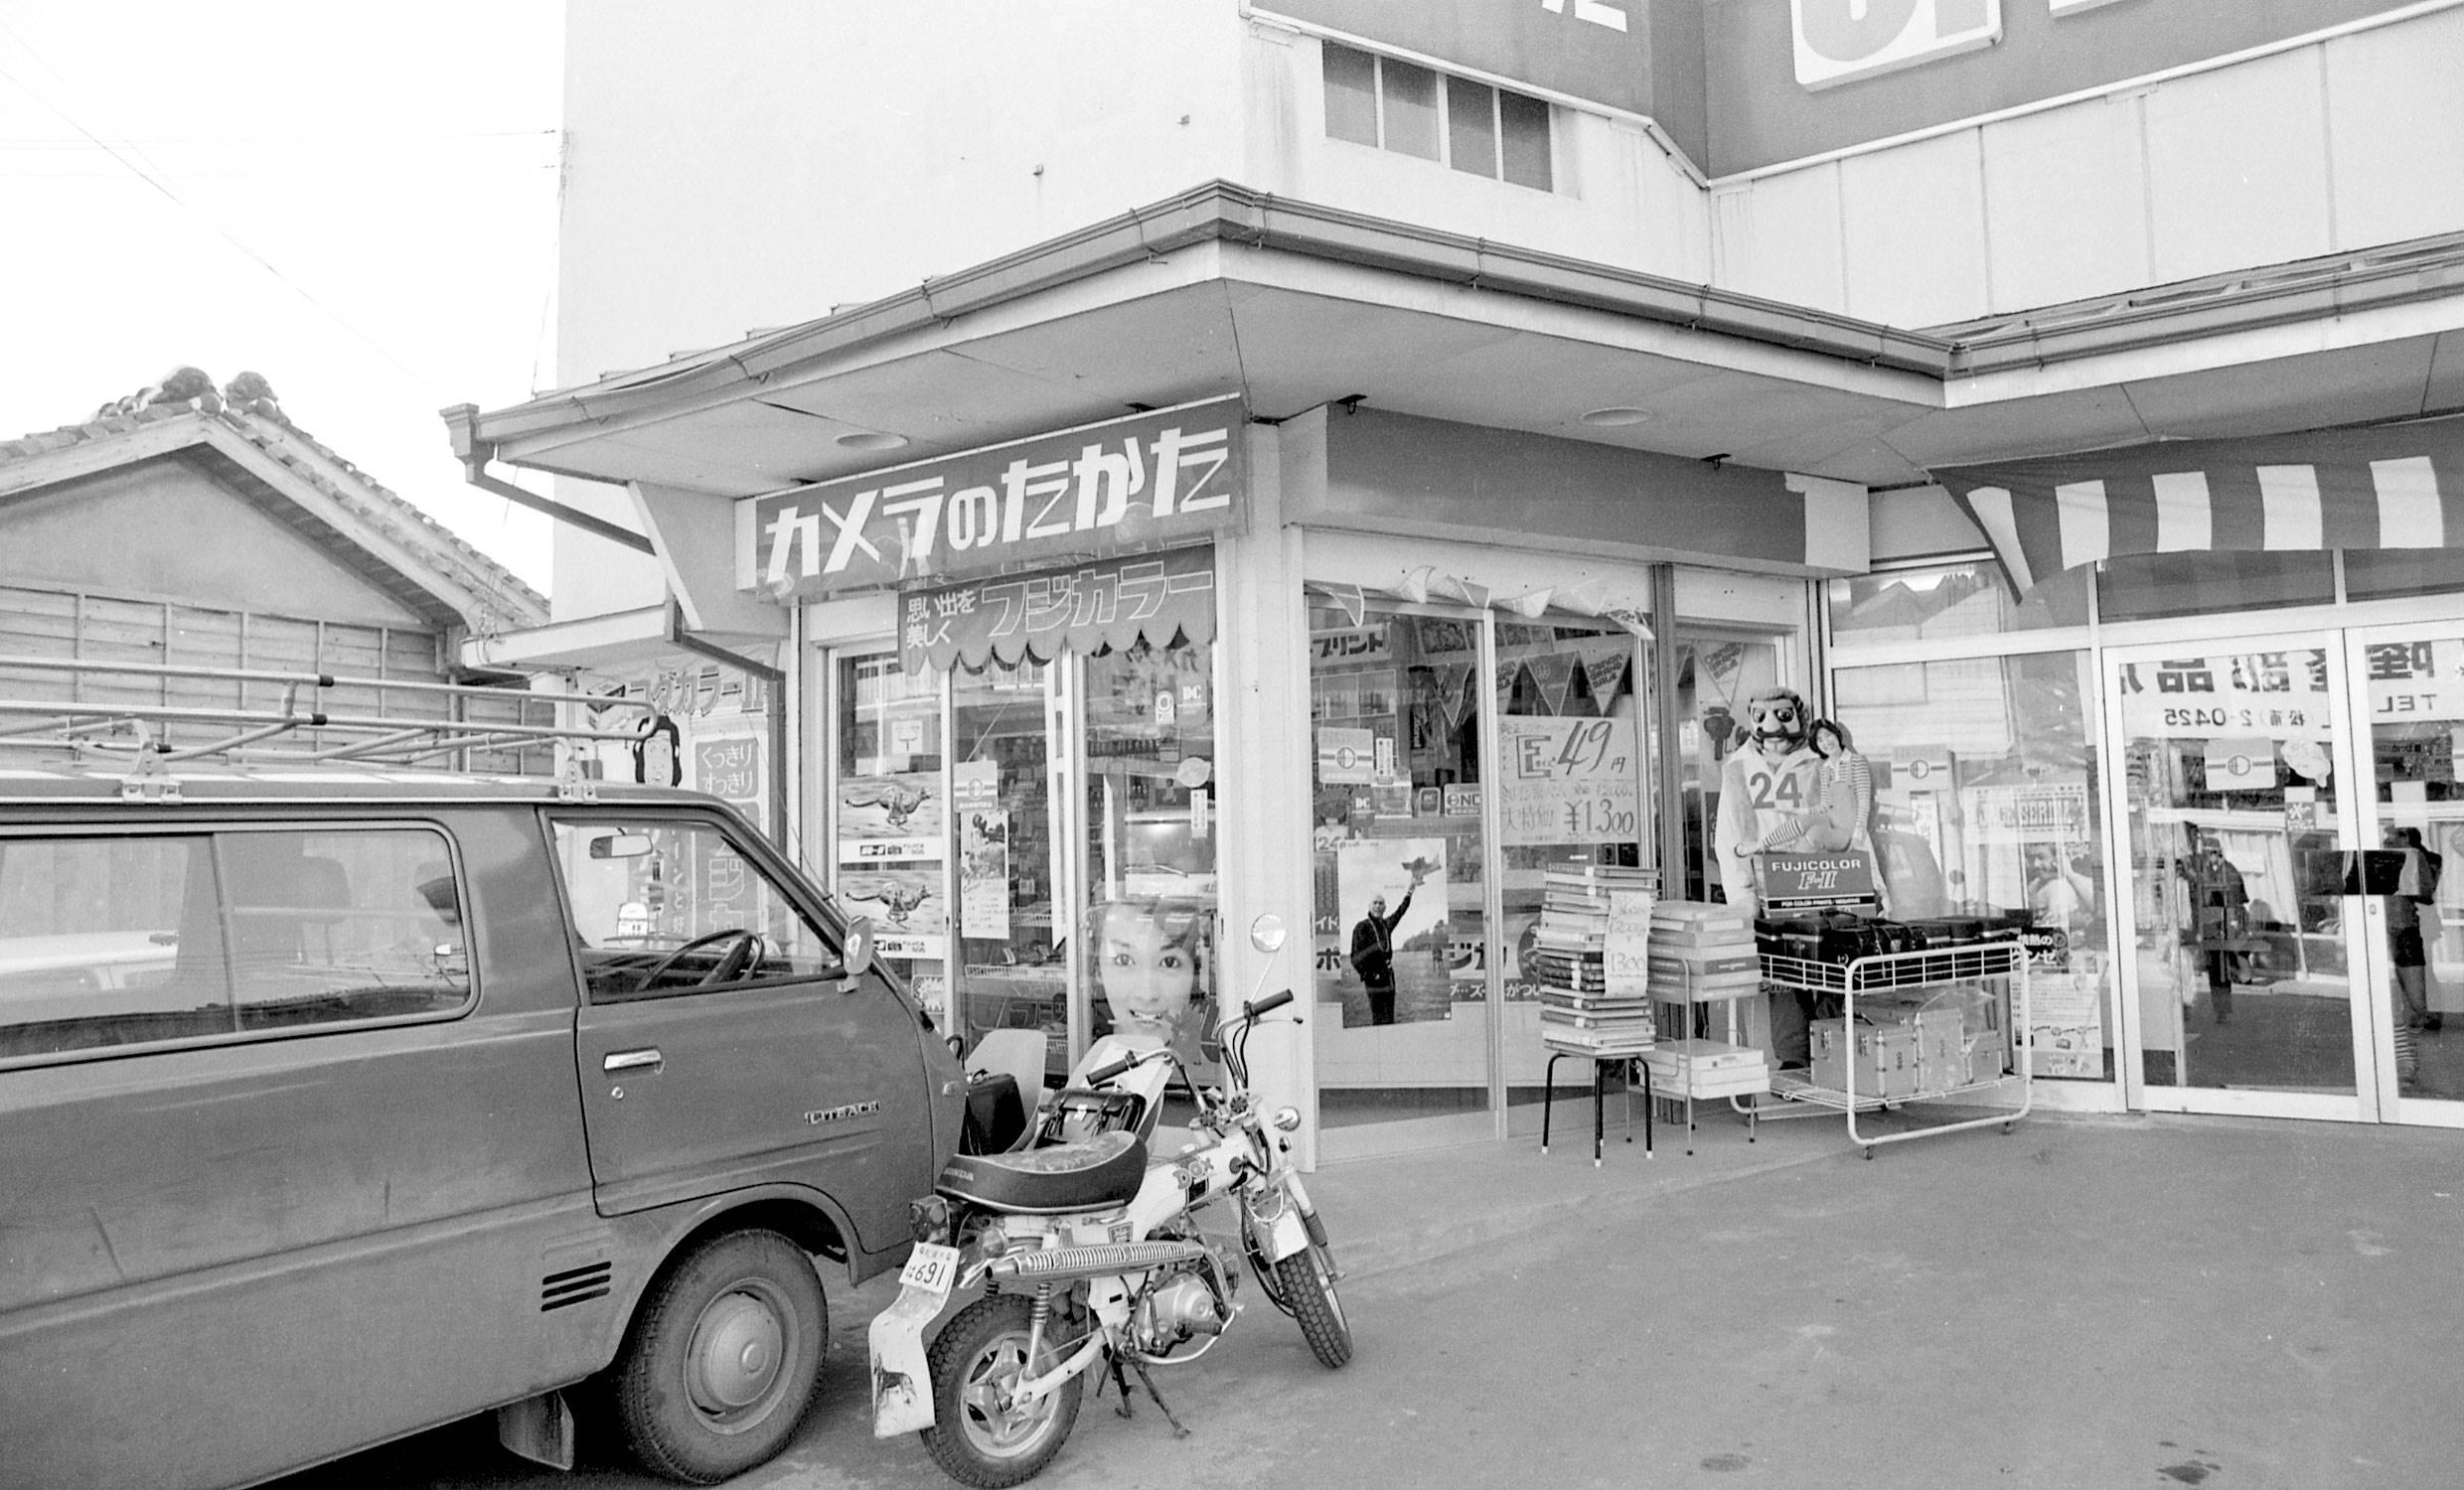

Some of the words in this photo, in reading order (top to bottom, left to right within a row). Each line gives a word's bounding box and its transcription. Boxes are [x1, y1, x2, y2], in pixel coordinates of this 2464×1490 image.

[766, 427, 1231, 584] カメラのたかた
[906, 589, 976, 624] 思い出を
[982, 560, 1213, 637] フジカラー
[906, 620, 952, 650] 美しく
[700, 743, 752, 770] くっきり
[700, 770, 753, 796] すっきり
[1750, 772, 1802, 810] 24
[1771, 858, 1861, 872] FUJICOLOR
[1797, 870, 1838, 890] F-II
[914, 1261, 946, 1287] 691
